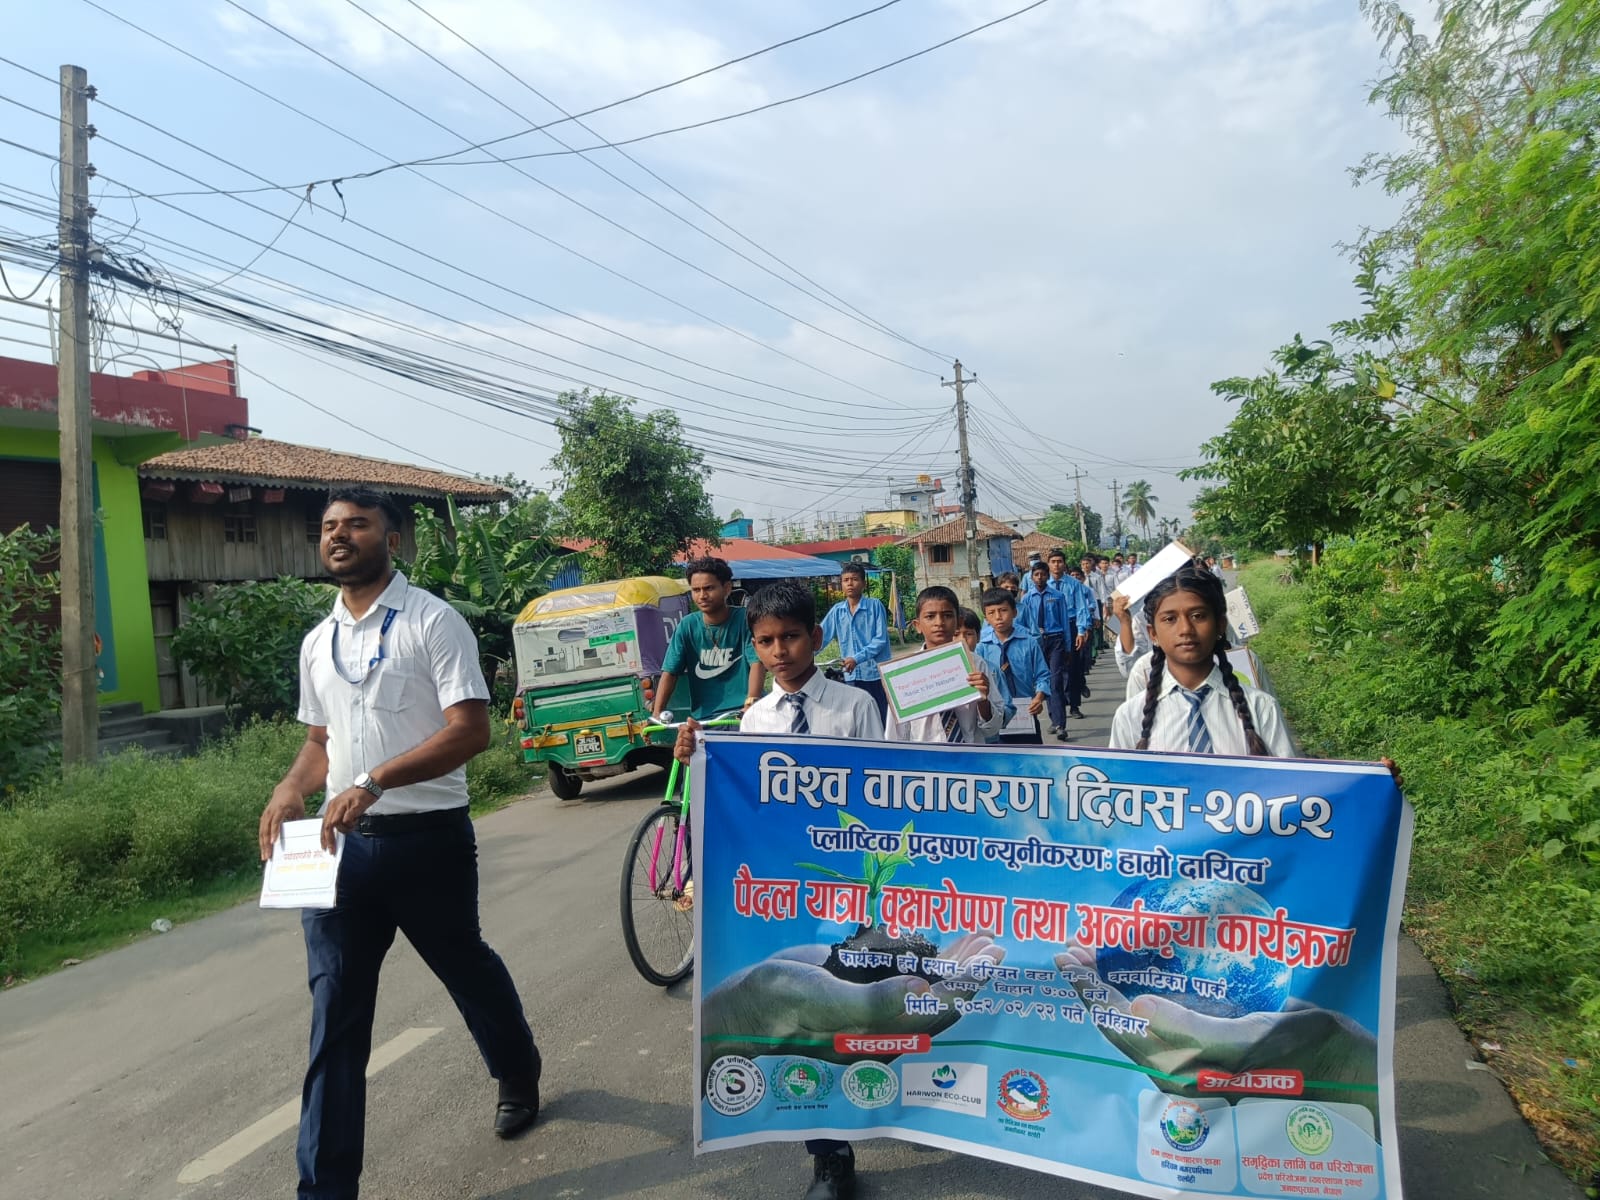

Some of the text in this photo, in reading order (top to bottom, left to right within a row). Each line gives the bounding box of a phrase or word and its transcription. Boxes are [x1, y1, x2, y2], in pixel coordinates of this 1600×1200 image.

[700, 647, 733, 666] NIKE
[759, 750, 1334, 839] विश्व वातावरण दिवस-२०८२
[908, 833, 978, 863] प्रदुषण
[1118, 846, 1173, 879] हाम्रो
[733, 864, 800, 920] पैदल
[805, 880, 873, 929] यात्रा,
[880, 879, 1006, 938] वृक्षारोपण
[1012, 899, 1069, 942] तथा
[1215, 907, 1357, 968] कार्यक्रम
[971, 961, 1021, 980] हरिवन
[1108, 965, 1188, 992] वनवाटिका
[1192, 978, 1228, 999] पार्क
[1061, 1002, 1084, 1024] गते
[845, 1035, 919, 1052] सहकार्य
[1203, 1072, 1297, 1089] आयोजक
[906, 1090, 943, 1098] HARIWON
[943, 1092, 982, 1104] ECO-CLUB
[1327, 1159, 1374, 1175] परियोजना
